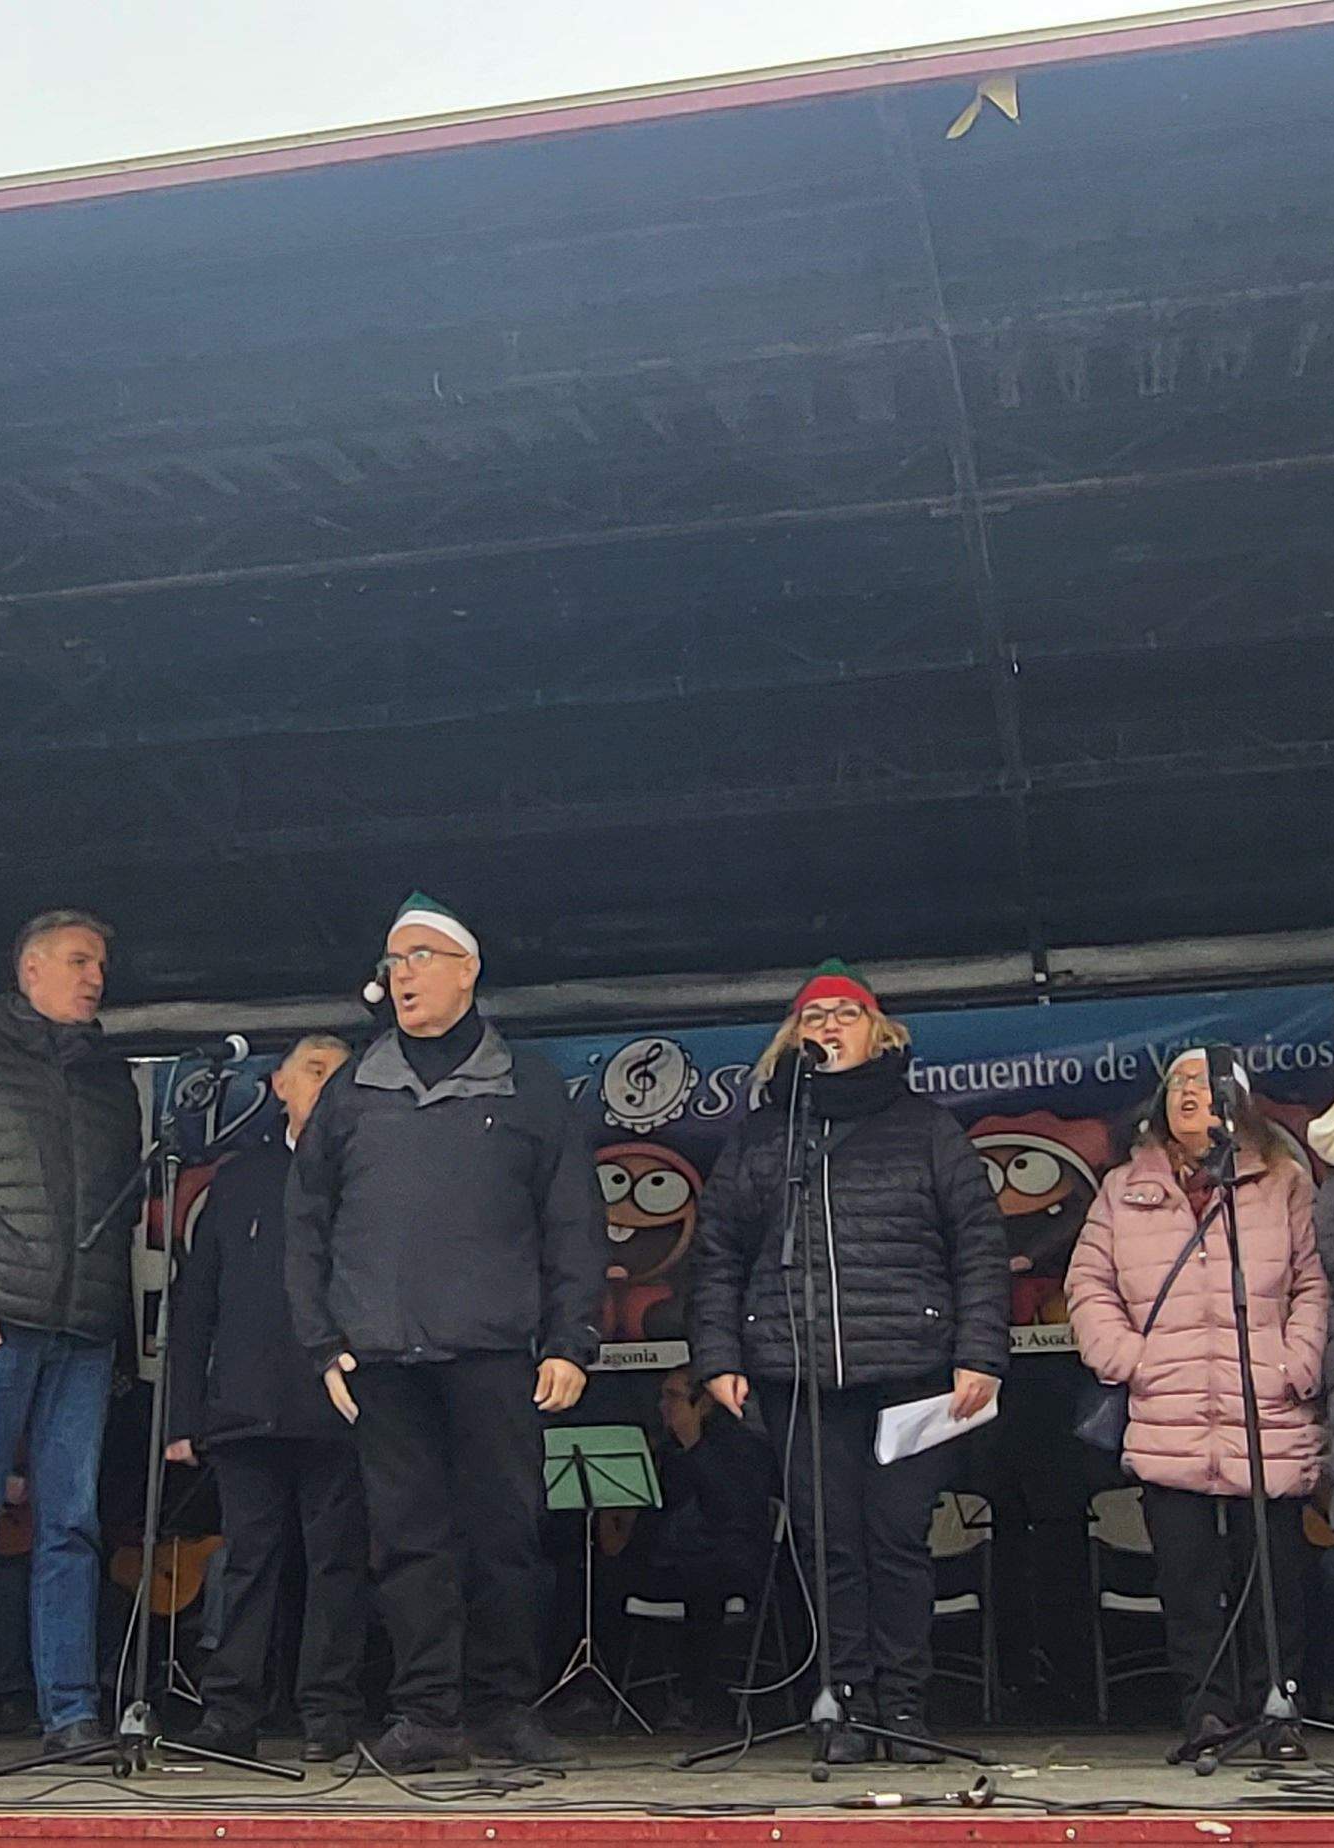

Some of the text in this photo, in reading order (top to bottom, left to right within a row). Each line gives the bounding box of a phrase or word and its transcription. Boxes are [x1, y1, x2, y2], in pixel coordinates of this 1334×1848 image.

[907, 1034, 1334, 1094] Encuentro de Vcicos
